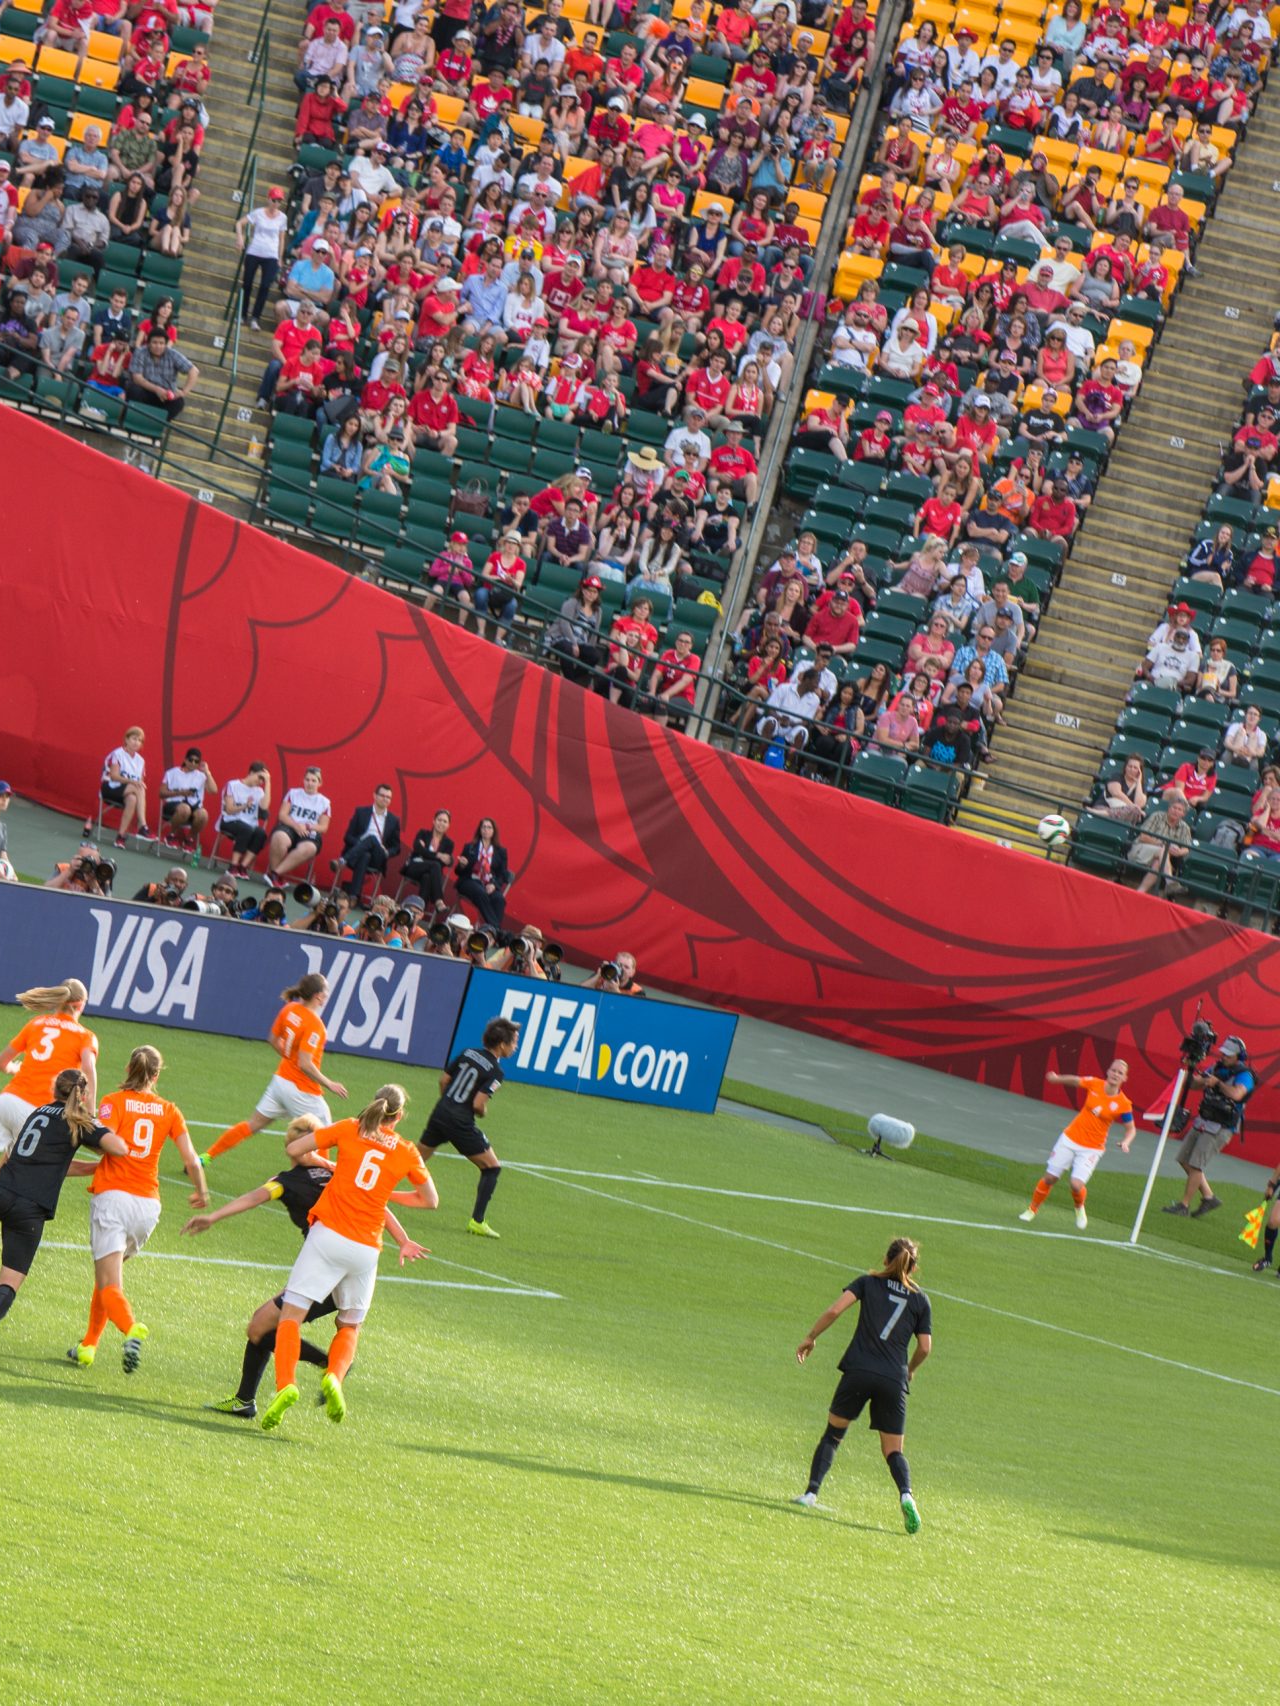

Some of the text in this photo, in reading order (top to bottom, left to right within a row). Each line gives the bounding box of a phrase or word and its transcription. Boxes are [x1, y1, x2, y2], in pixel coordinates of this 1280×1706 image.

[290, 804, 317, 821] FIFA
[88, 908, 209, 1020] VISA
[300, 943, 422, 1055] VISA
[31, 1027, 61, 1061] 3
[446, 1062, 479, 1103] 10
[125, 1099, 164, 1116] MIEDEMA
[17, 1115, 50, 1157] 6
[129, 1118, 155, 1159] 9
[354, 1149, 386, 1191] 6
[879, 1294, 908, 1341] 7
